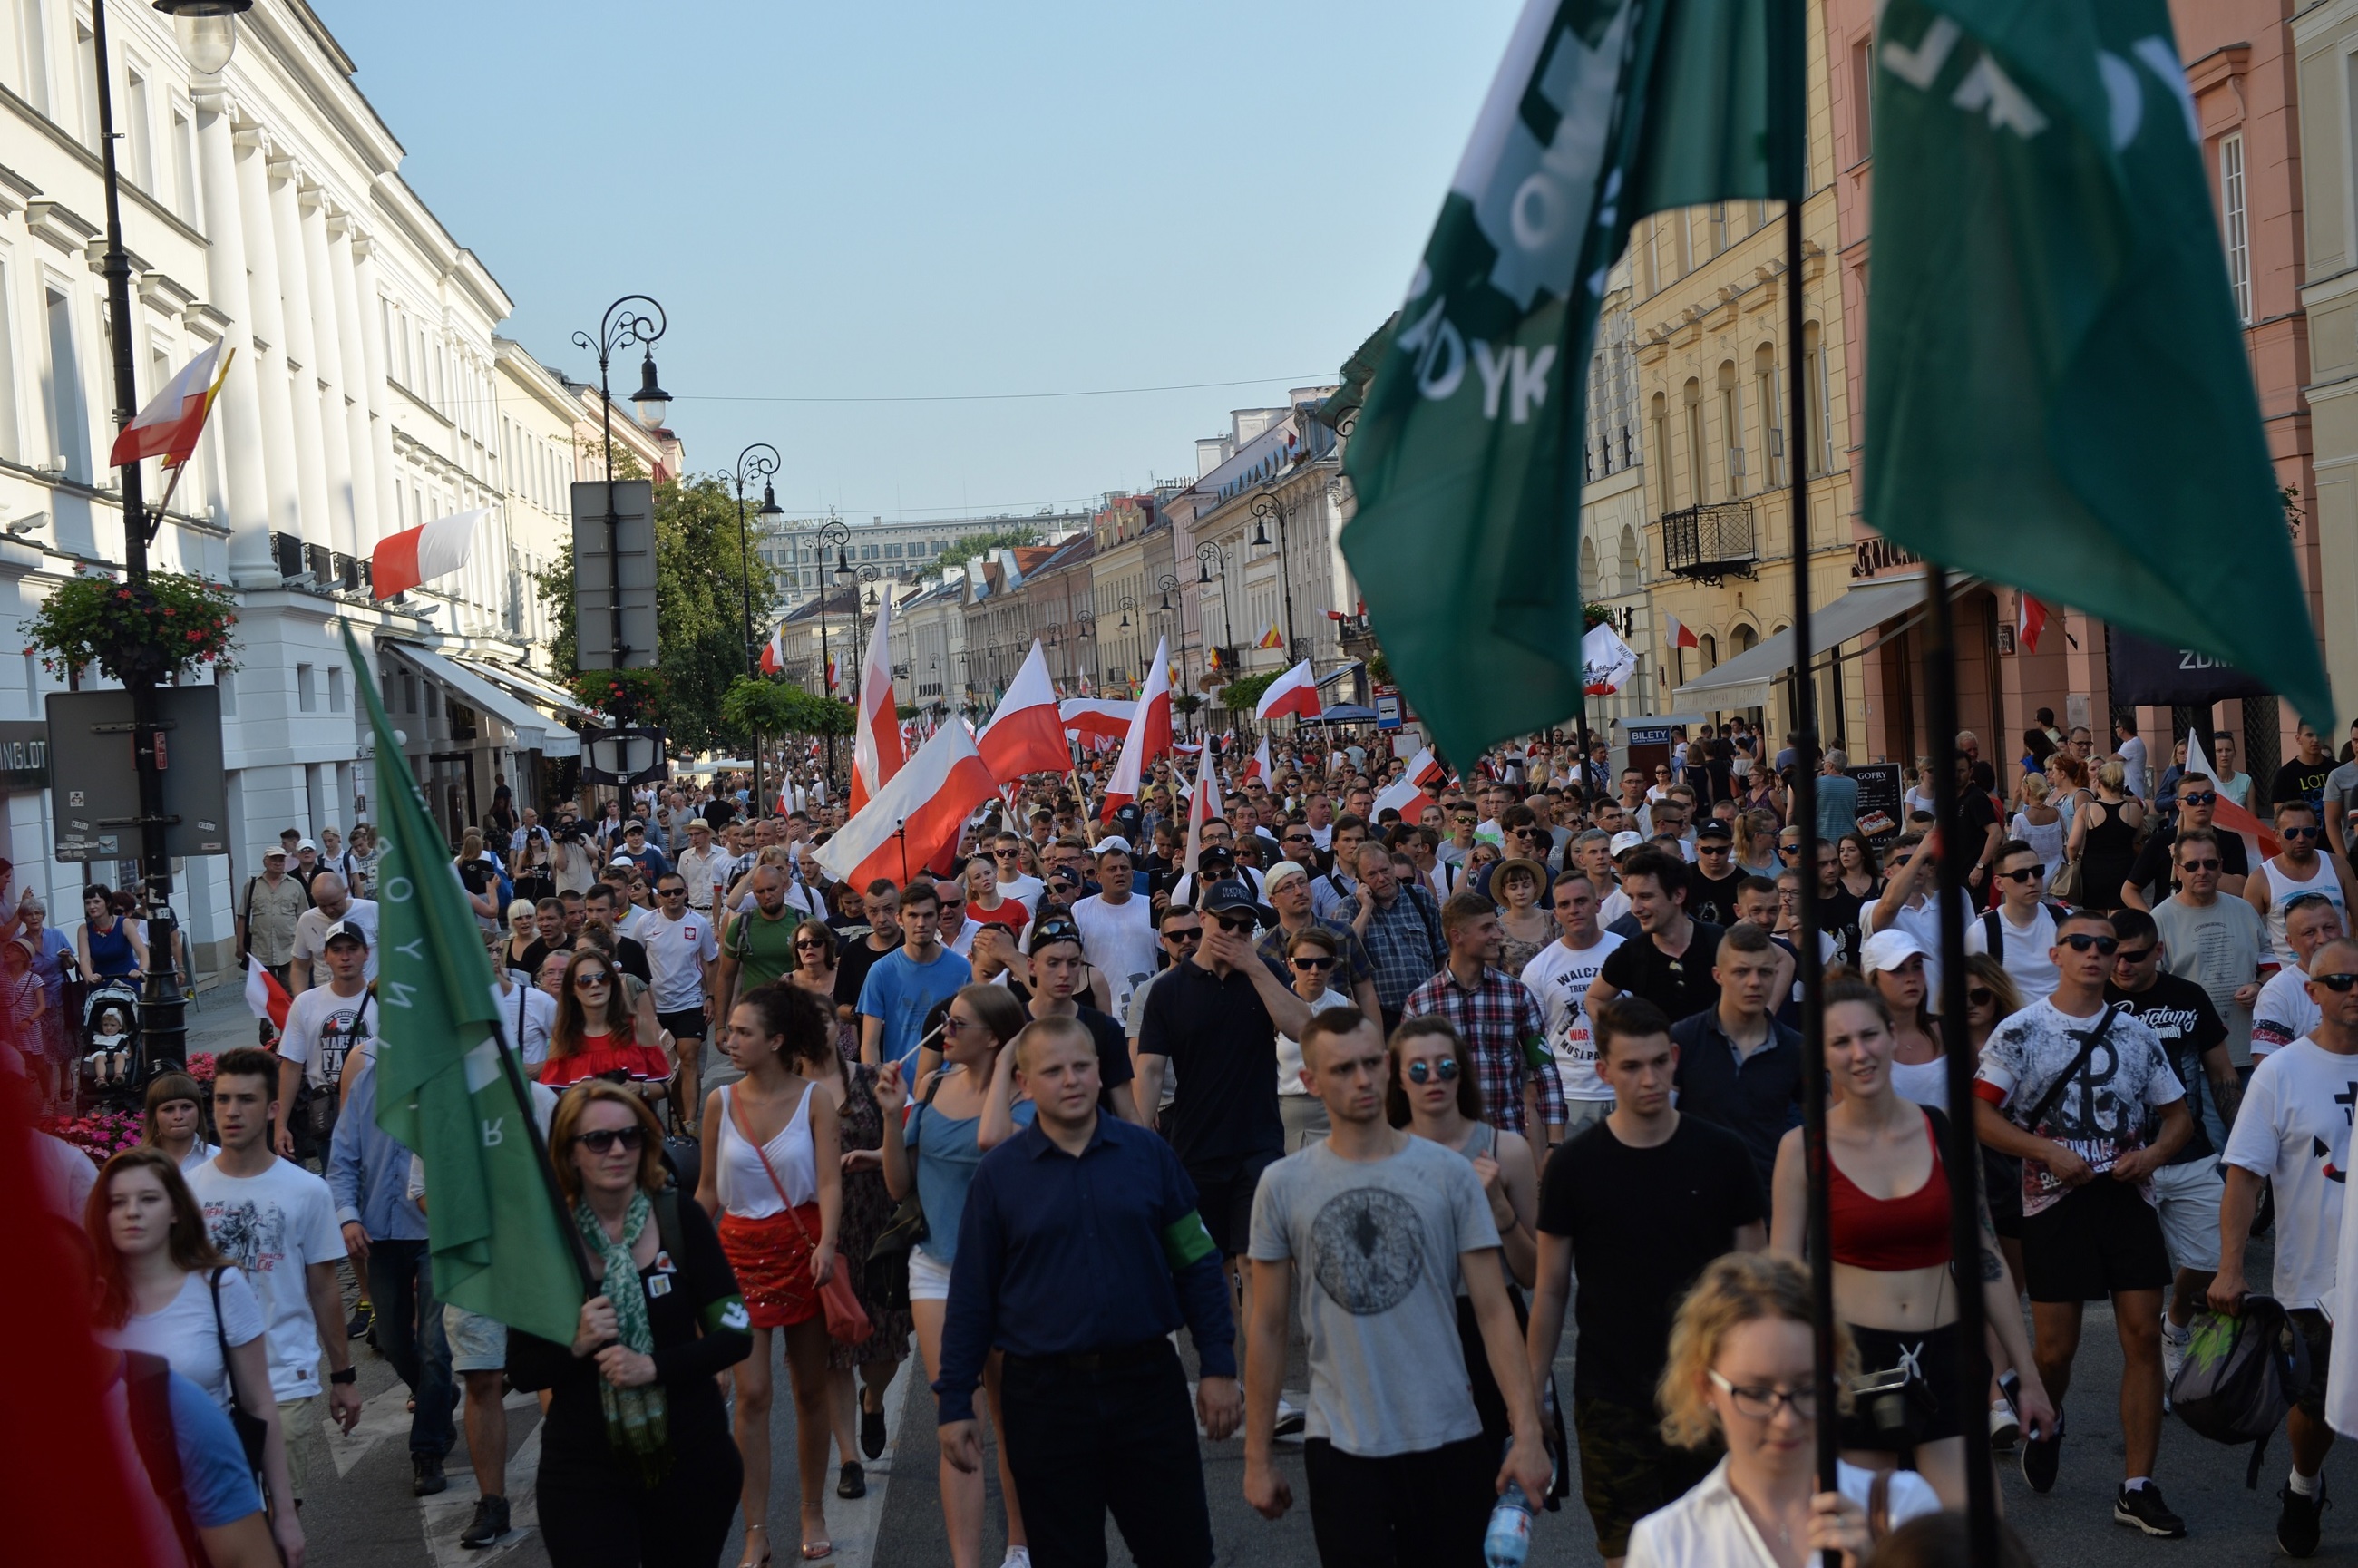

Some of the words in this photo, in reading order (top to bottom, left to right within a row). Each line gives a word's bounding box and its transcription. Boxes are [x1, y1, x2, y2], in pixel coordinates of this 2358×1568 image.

[1632, 730, 1667, 740] BILETY
[1857, 771, 1887, 780] GOFRY
[1556, 967, 1600, 987] WALCZ
[322, 1050, 344, 1071] FA
